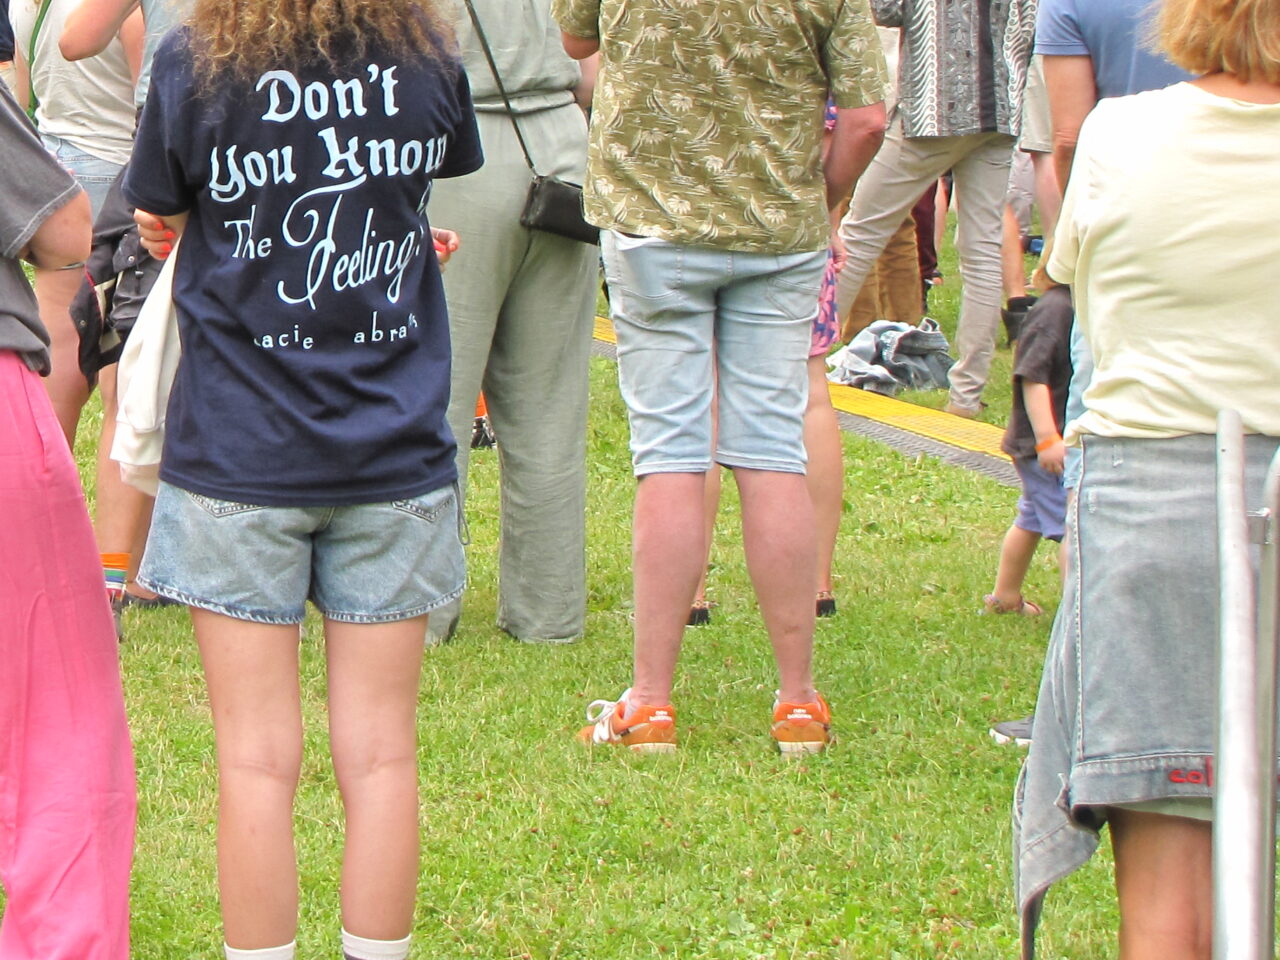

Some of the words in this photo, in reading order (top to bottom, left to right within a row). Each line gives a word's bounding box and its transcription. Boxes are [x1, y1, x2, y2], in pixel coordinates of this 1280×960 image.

[256, 64, 399, 122] Don't
[209, 145, 297, 202] You
[224, 205, 272, 259] The
[254, 325, 314, 350] acie
[354, 311, 418, 343] abra
[1168, 755, 1214, 788] col
